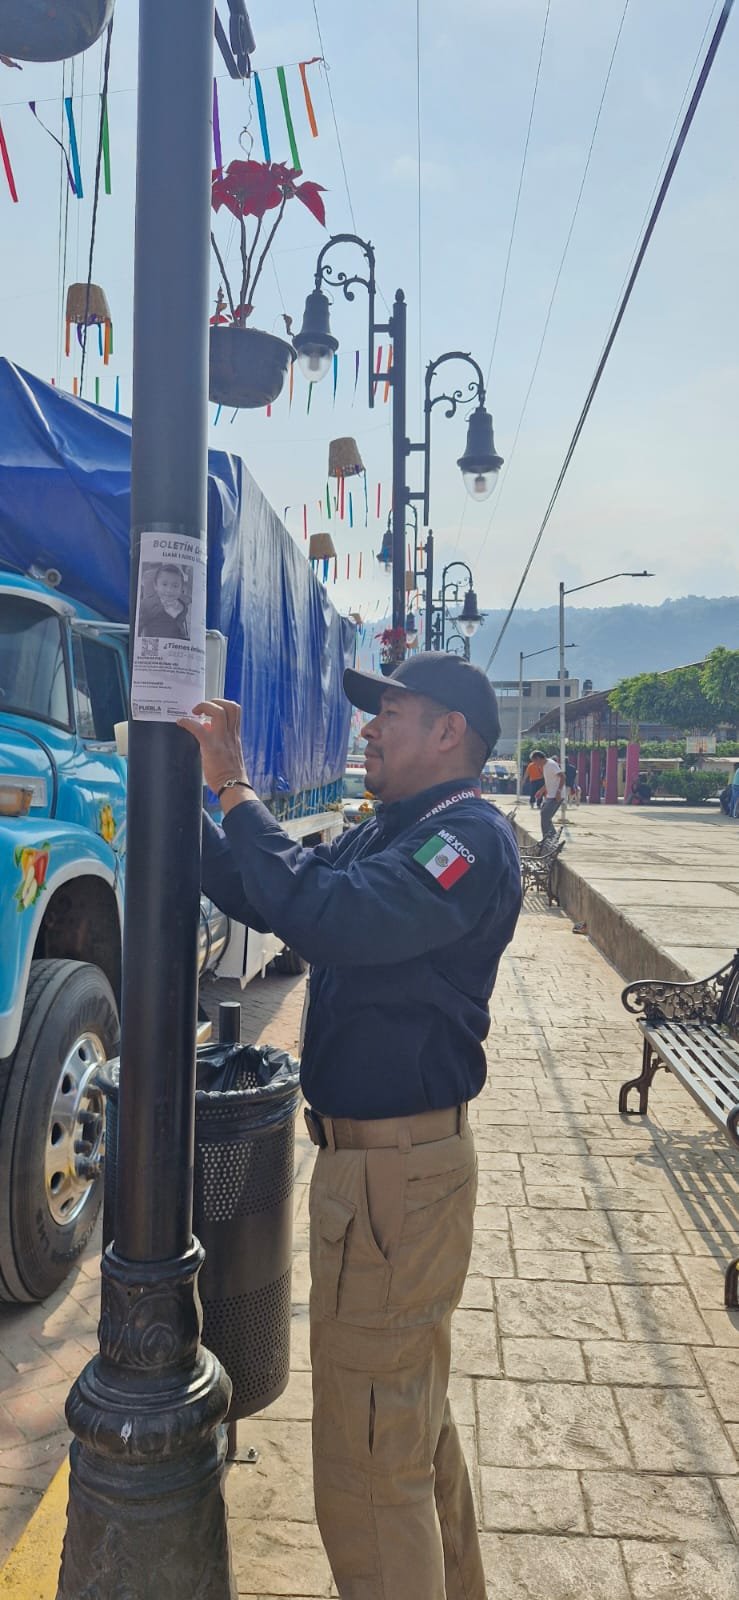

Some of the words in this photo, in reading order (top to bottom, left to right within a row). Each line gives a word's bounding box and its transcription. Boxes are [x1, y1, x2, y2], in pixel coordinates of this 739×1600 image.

[153, 539, 193, 553] BOLETÍN
[163, 642, 190, 651] ¿Tienes
[438, 829, 475, 863] MÉXICO
